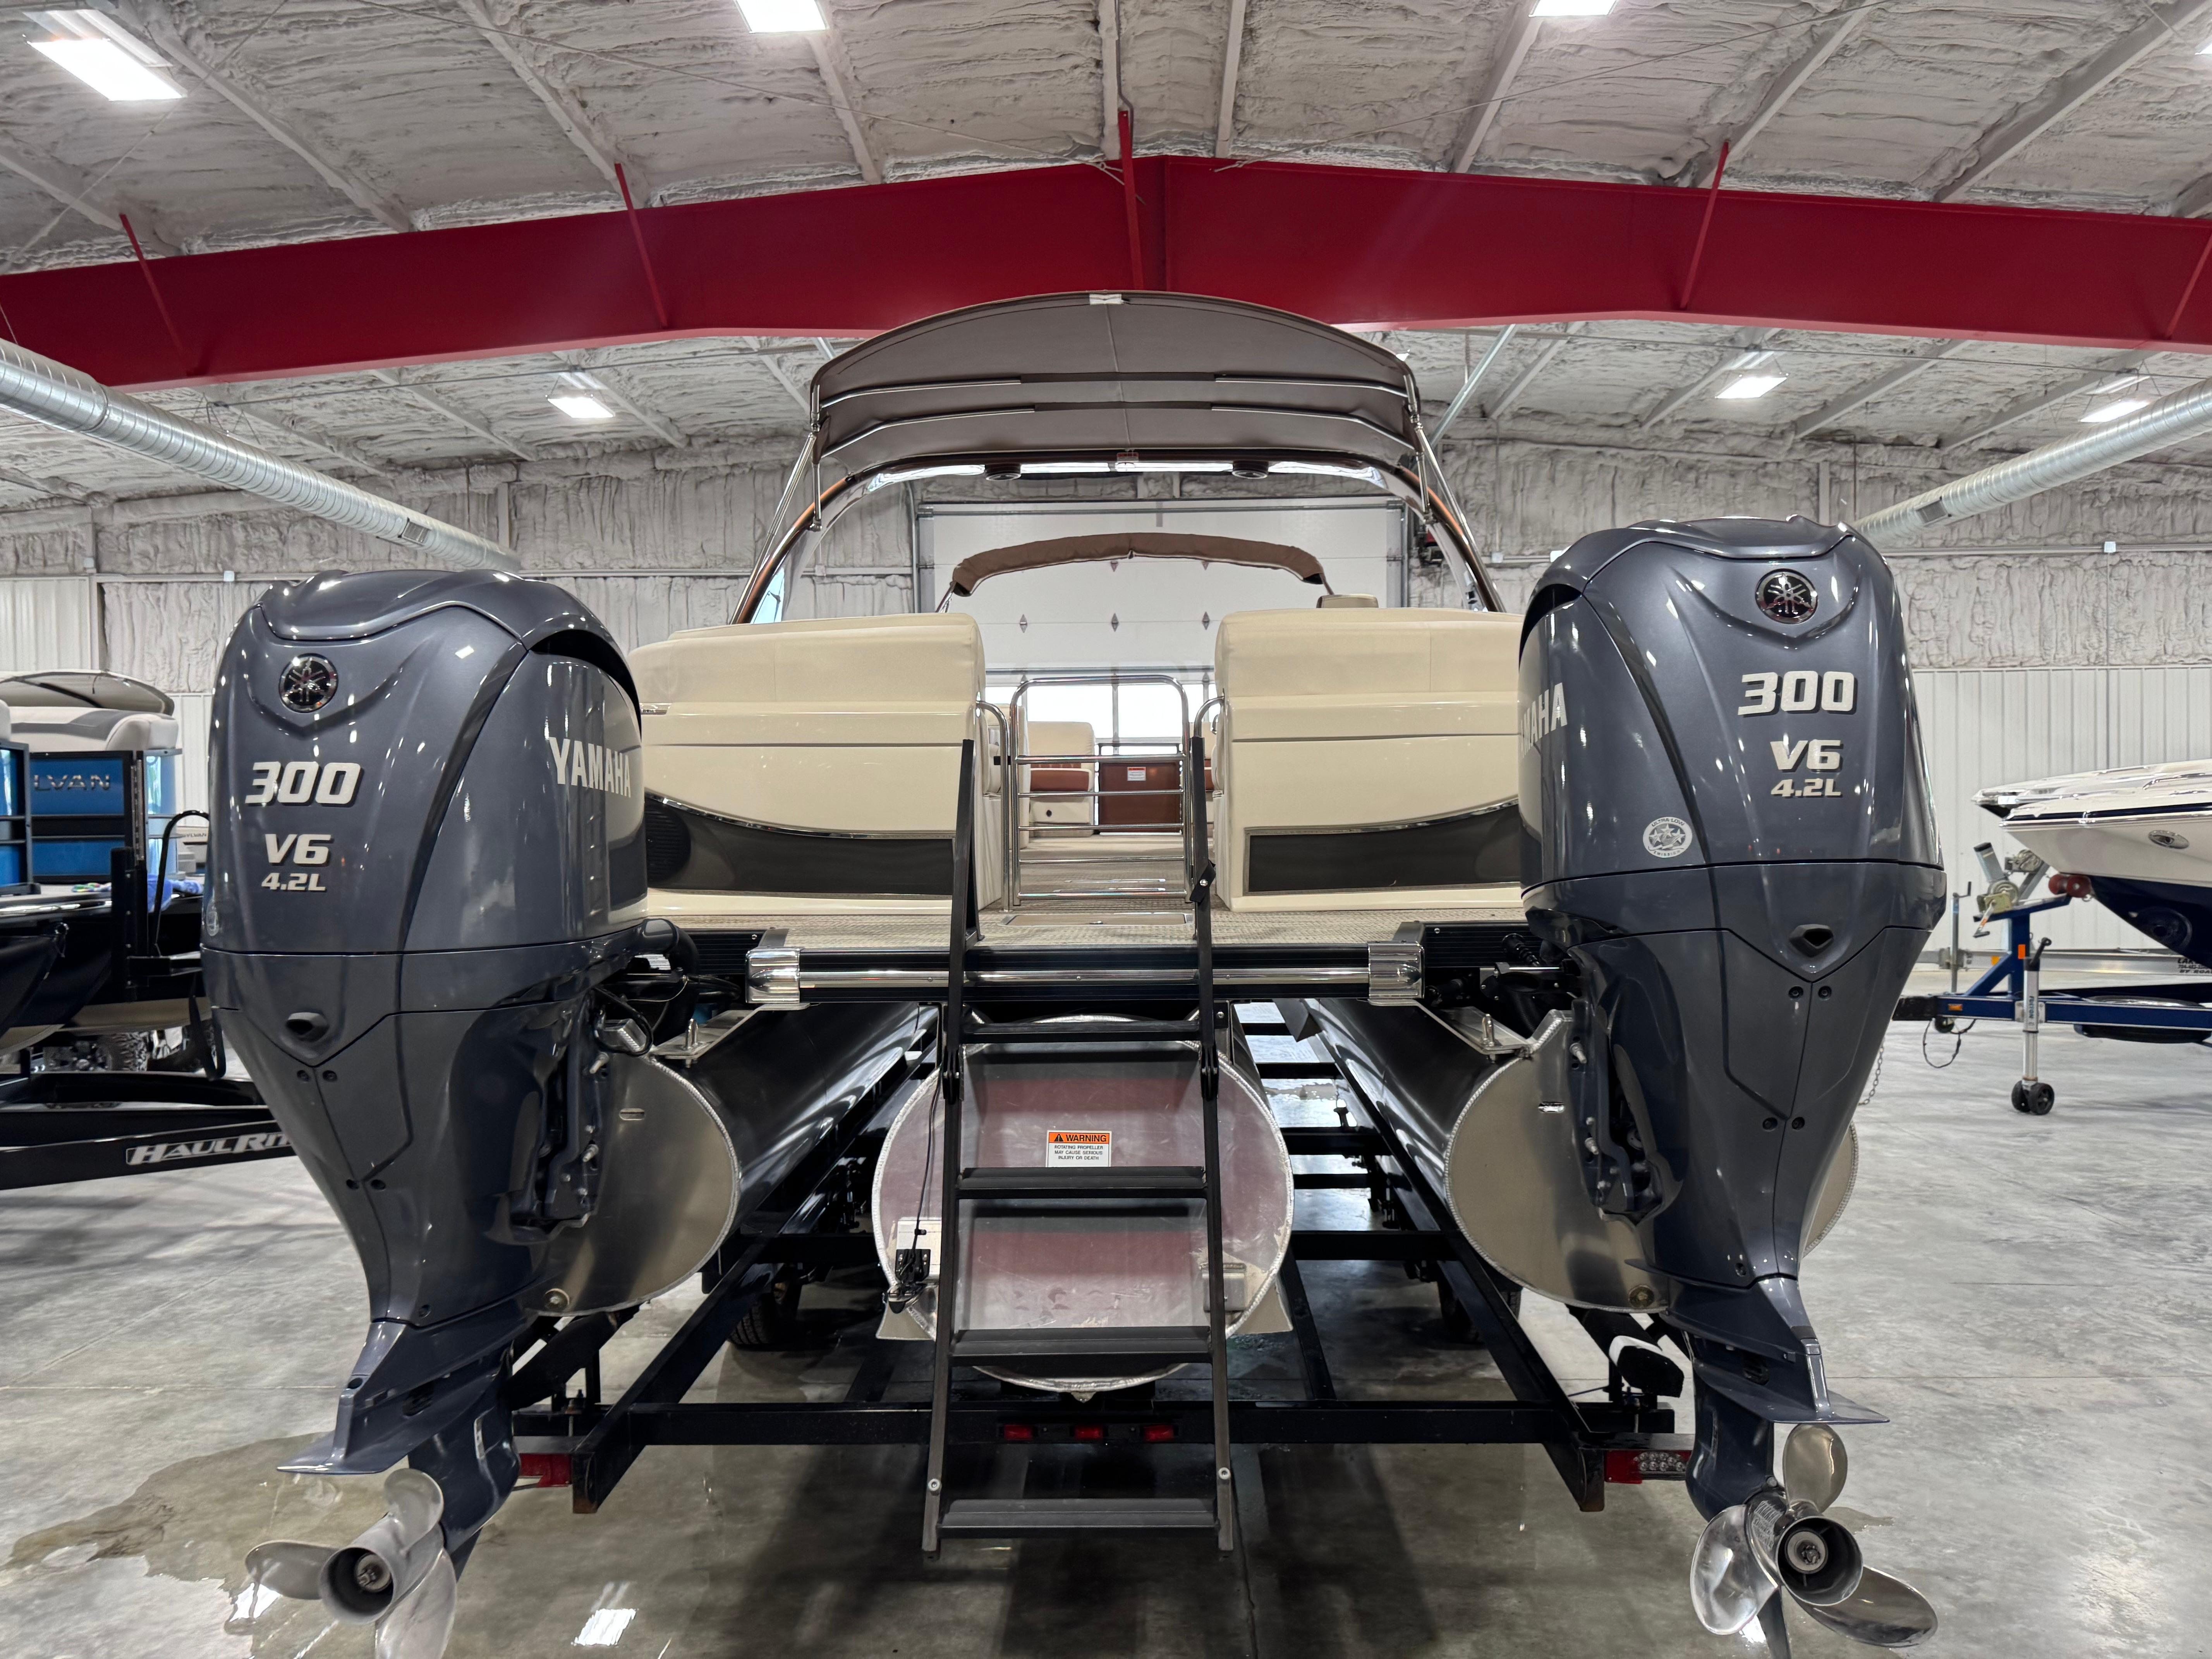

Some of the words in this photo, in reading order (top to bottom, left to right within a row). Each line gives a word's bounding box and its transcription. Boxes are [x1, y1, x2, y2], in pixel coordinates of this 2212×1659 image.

[1738, 671, 1855, 715] 300
[549, 737, 631, 798] YAMAHA
[1770, 739, 1841, 770] V6
[245, 761, 361, 804] 300
[1771, 778, 1841, 797] 4.2L
[265, 833, 331, 864] V6
[261, 872, 326, 891] 4.2L
